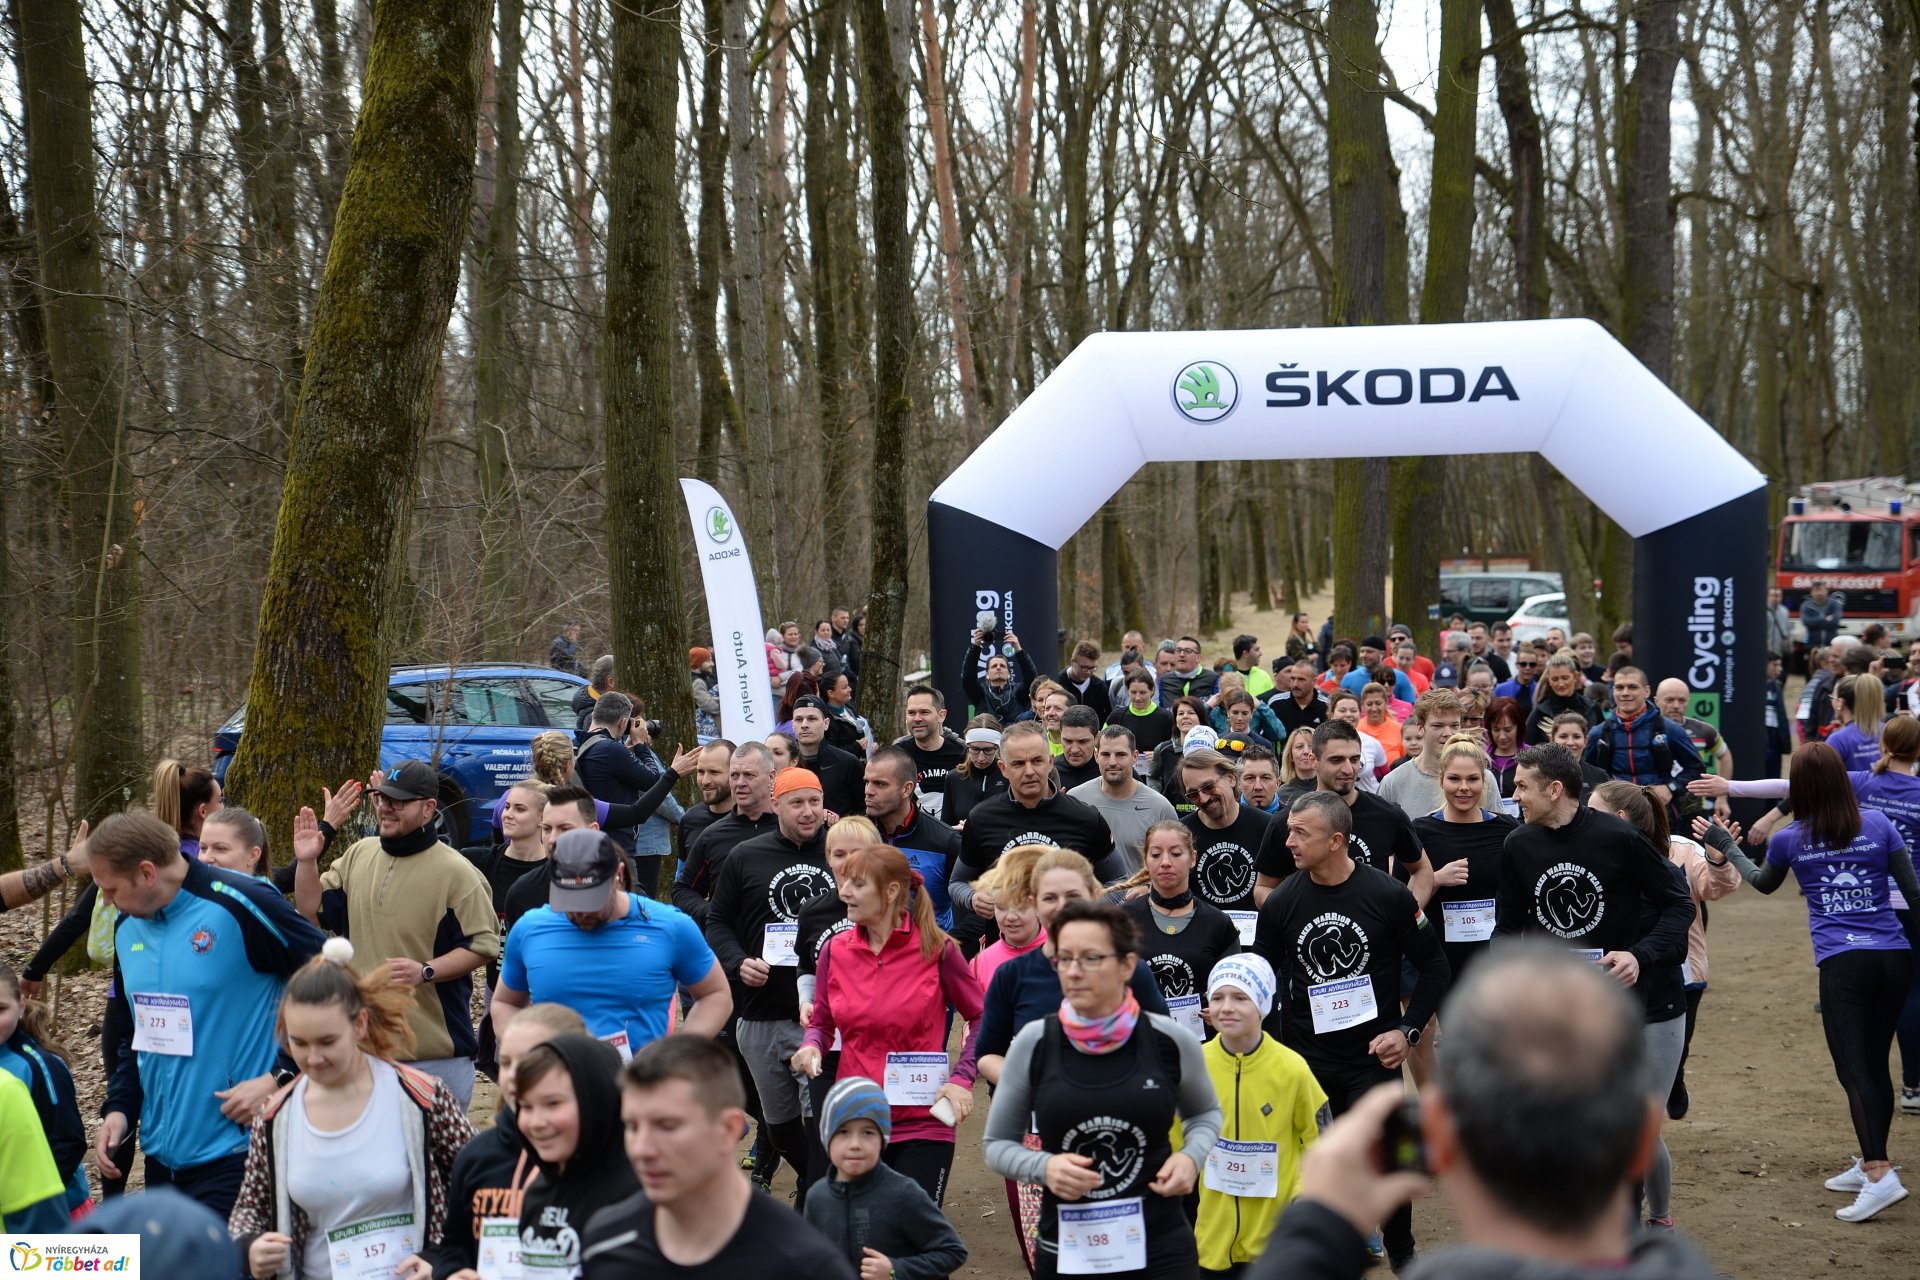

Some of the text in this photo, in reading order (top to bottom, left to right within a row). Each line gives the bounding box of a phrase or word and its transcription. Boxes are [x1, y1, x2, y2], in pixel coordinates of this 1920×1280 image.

[1266, 363, 1520, 407] ŠKODA
[1722, 576, 1734, 628] ŠKODA
[1687, 576, 1721, 690] Cycling
[484, 763, 511, 771] VALENT
[1016, 832, 1052, 845] WARRIOR
[1206, 842, 1239, 854] WARRIOR
[1240, 847, 1254, 864] TEAM
[1798, 842, 1880, 862] Jótékony sportoló vagyok.
[785, 864, 821, 875] WARRIOR
[1534, 862, 1604, 897] NAKED WARRIOR TEAM
[1821, 887, 1873, 904] BÁTOR
[1461, 916, 1476, 925] 105
[1297, 912, 1369, 945] NAKED WARRIOR TEAM
[1312, 987, 1327, 996] SPURI
[1331, 999, 1349, 1010] 223
[150, 1017, 166, 1028] 273
[909, 1073, 928, 1083] 143
[1227, 1143, 1274, 1152] NYÍREGYHÁZA
[1226, 1161, 1247, 1173] 291
[334, 1228, 356, 1240] SPURI
[357, 1215, 411, 1233] NYÍREGYHÁZA
[1087, 1233, 1110, 1247] 198
[363, 1243, 387, 1258] 157
